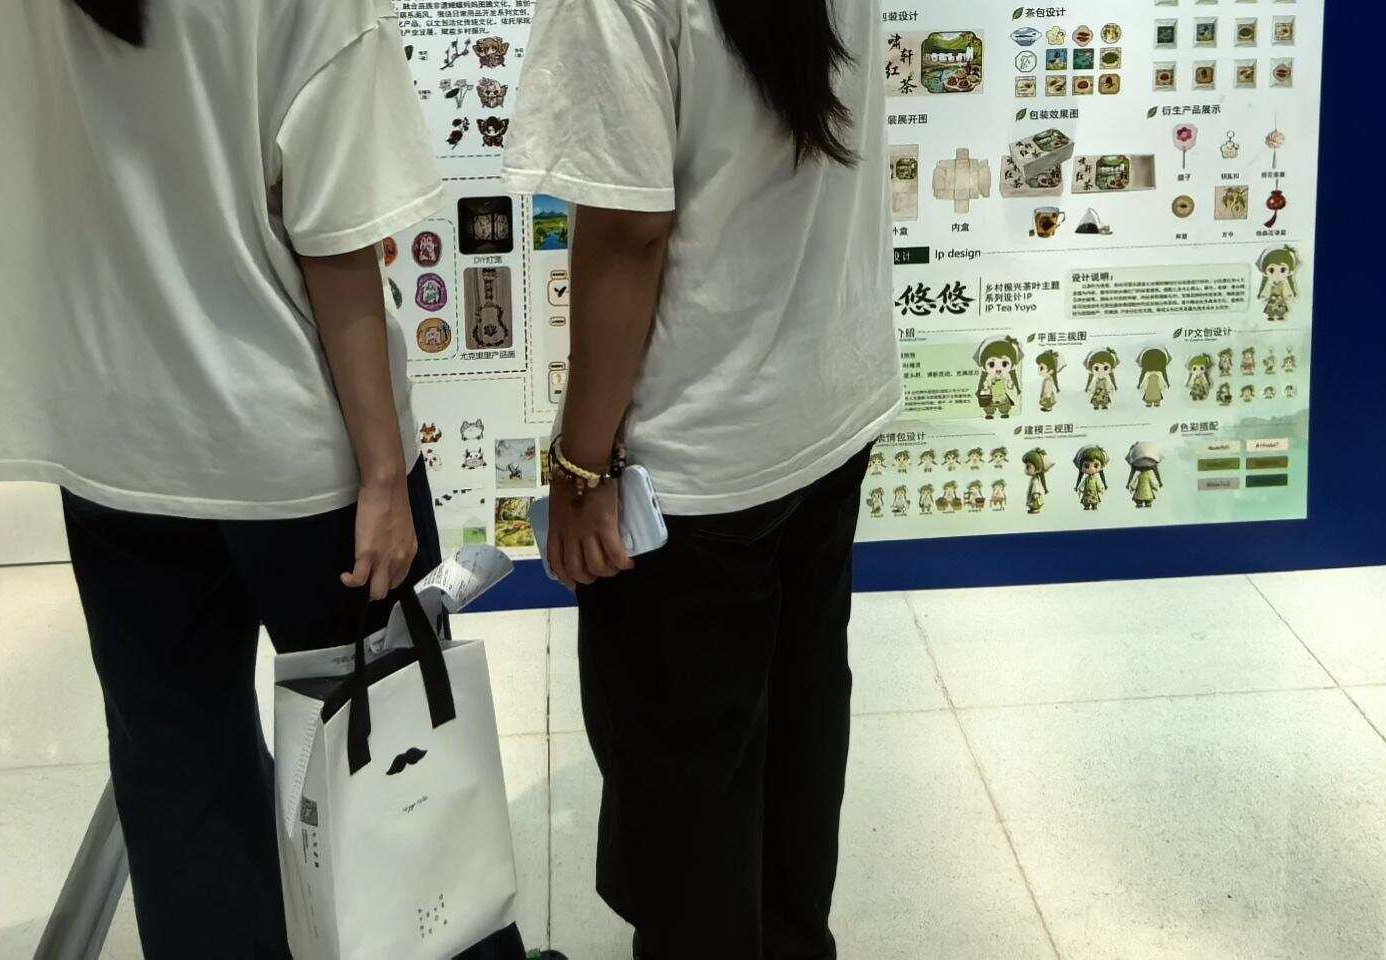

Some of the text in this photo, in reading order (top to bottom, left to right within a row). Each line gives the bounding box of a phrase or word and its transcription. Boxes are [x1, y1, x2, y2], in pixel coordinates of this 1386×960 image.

[1026, 7, 1066, 18] 茶包设计
[1029, 109, 1079, 121] 包装效果图
[1162, 104, 1221, 116] 衍生产品展示
[947, 248, 981, 260] design
[895, 280, 974, 317] 悠悠
[997, 303, 1011, 312] Tea
[1014, 302, 1037, 313] Yoyo
[1037, 331, 1087, 343] 平面三视图
